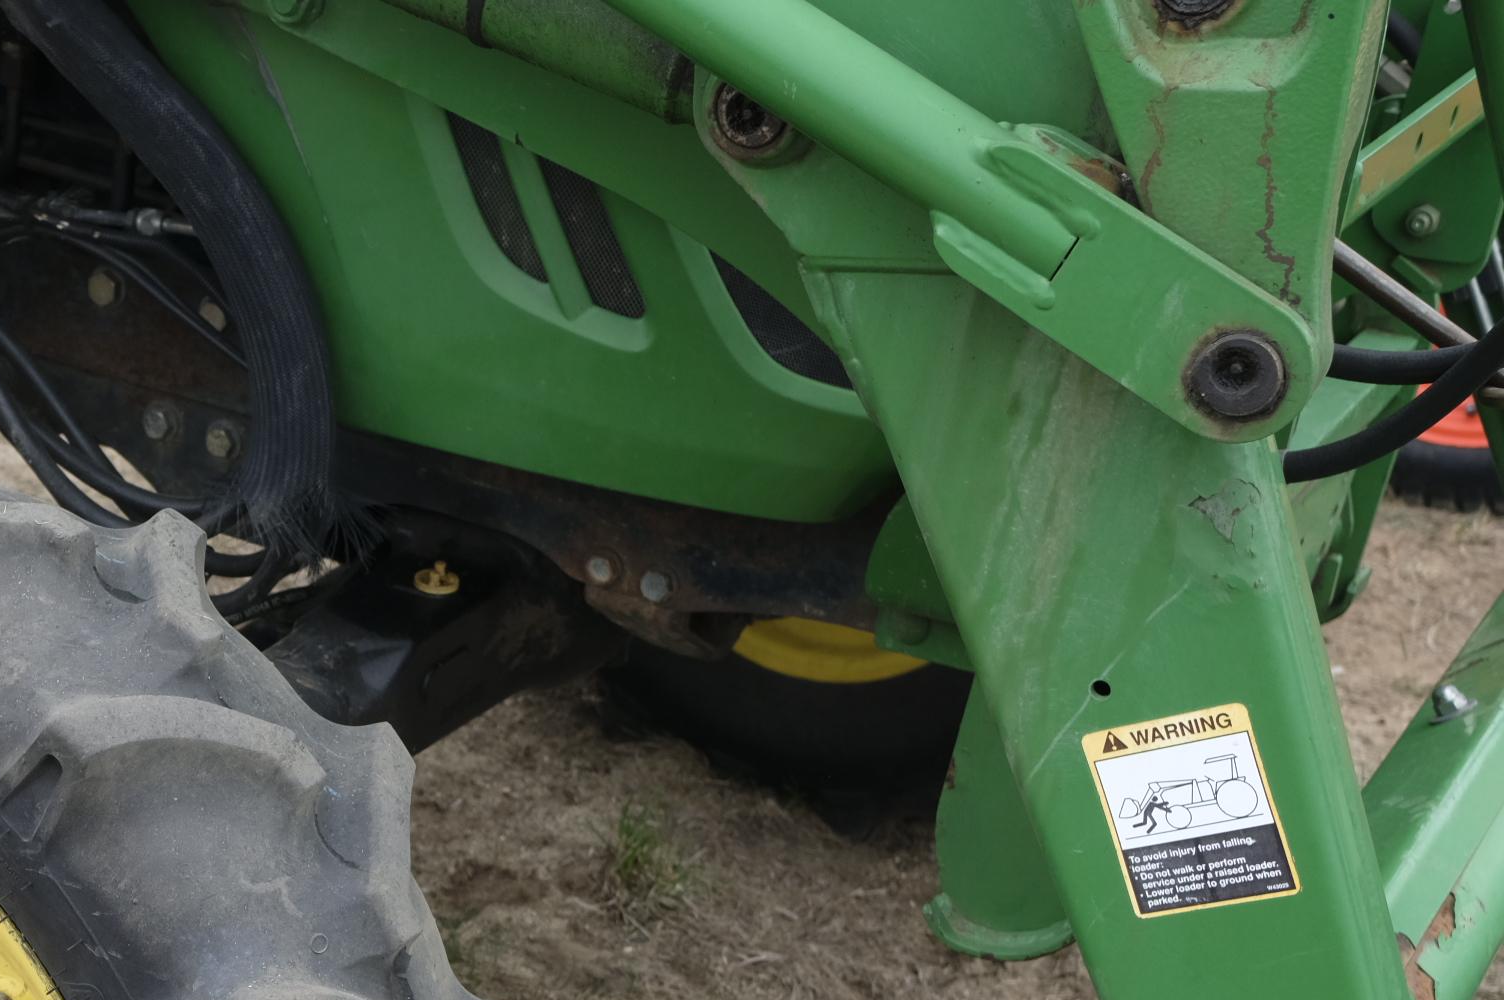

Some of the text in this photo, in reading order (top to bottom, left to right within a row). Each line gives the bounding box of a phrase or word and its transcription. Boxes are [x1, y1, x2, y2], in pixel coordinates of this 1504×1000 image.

[1130, 713, 1233, 746] WARNING
[1129, 856, 1140, 864] To
[1143, 850, 1167, 861] avoid
[1169, 846, 1196, 858] injury
[1198, 841, 1220, 852] from
[1140, 872, 1153, 880] Do
[1156, 869, 1171, 879] not
[1172, 865, 1194, 876] walk
[1208, 857, 1246, 869] perform
[1143, 880, 1175, 889] service
[1178, 873, 1205, 883] under
[1215, 866, 1244, 877] raised
[1246, 860, 1279, 872] loader.
[1146, 869, 1282, 898] Lower loader to ground when
[1148, 896, 1181, 908] parked.
